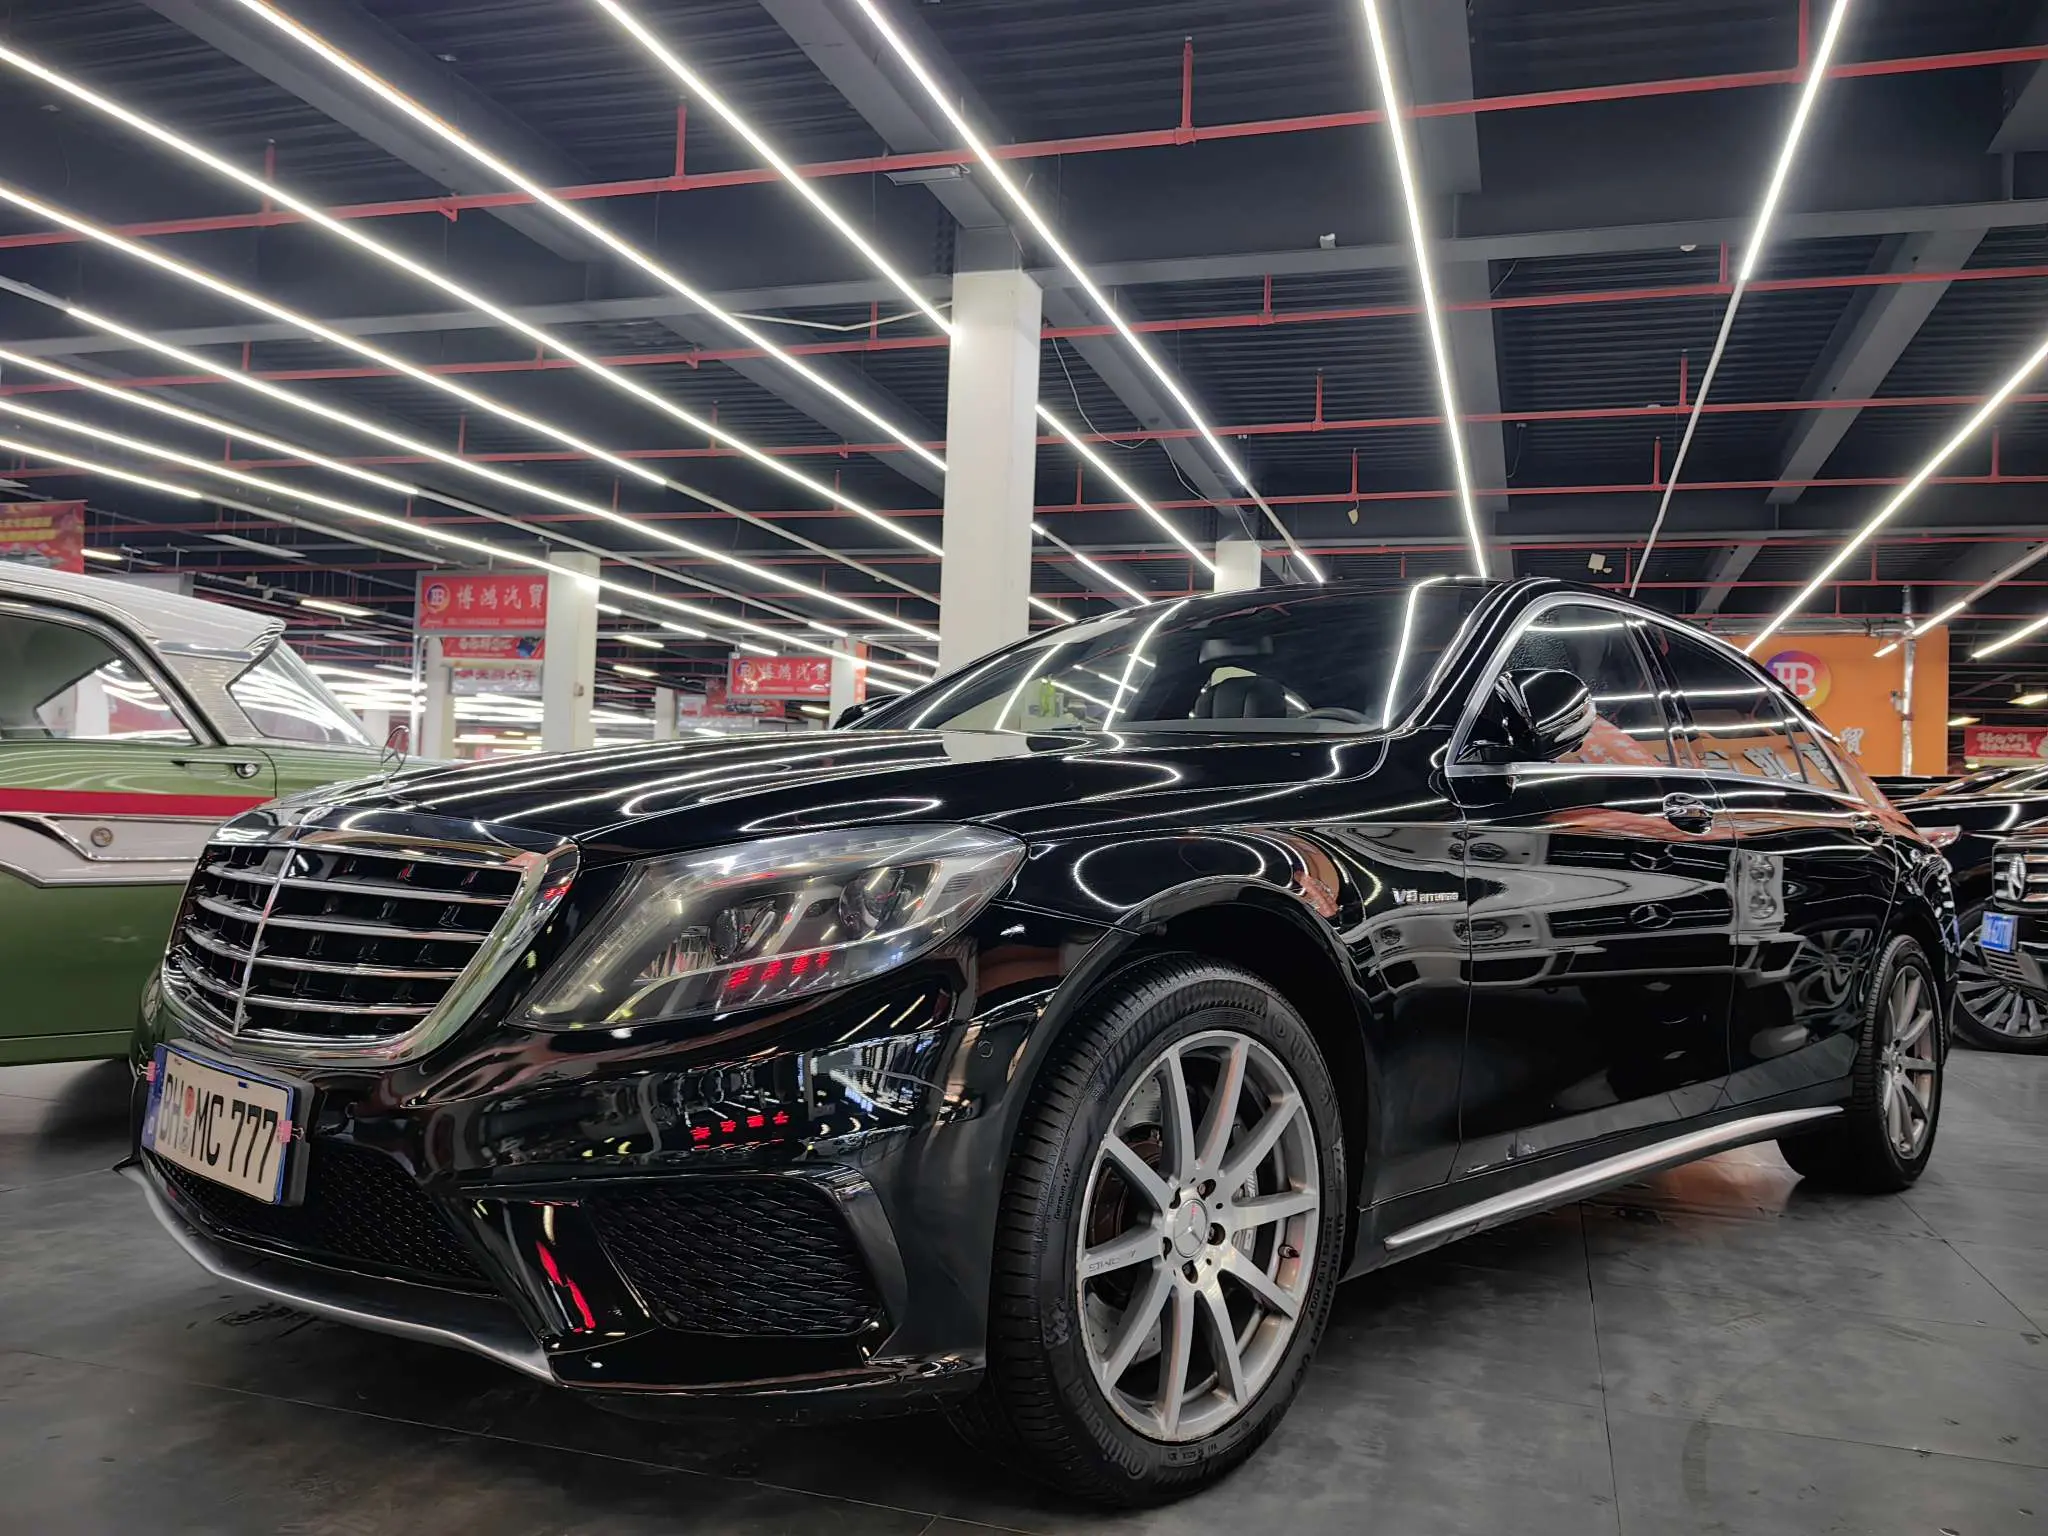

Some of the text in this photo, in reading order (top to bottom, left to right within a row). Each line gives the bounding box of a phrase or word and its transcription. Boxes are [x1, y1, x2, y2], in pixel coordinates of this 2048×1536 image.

[190, 1087, 225, 1167] MC
[227, 1099, 279, 1184] 777
[1064, 1378, 1150, 1480] Continental
